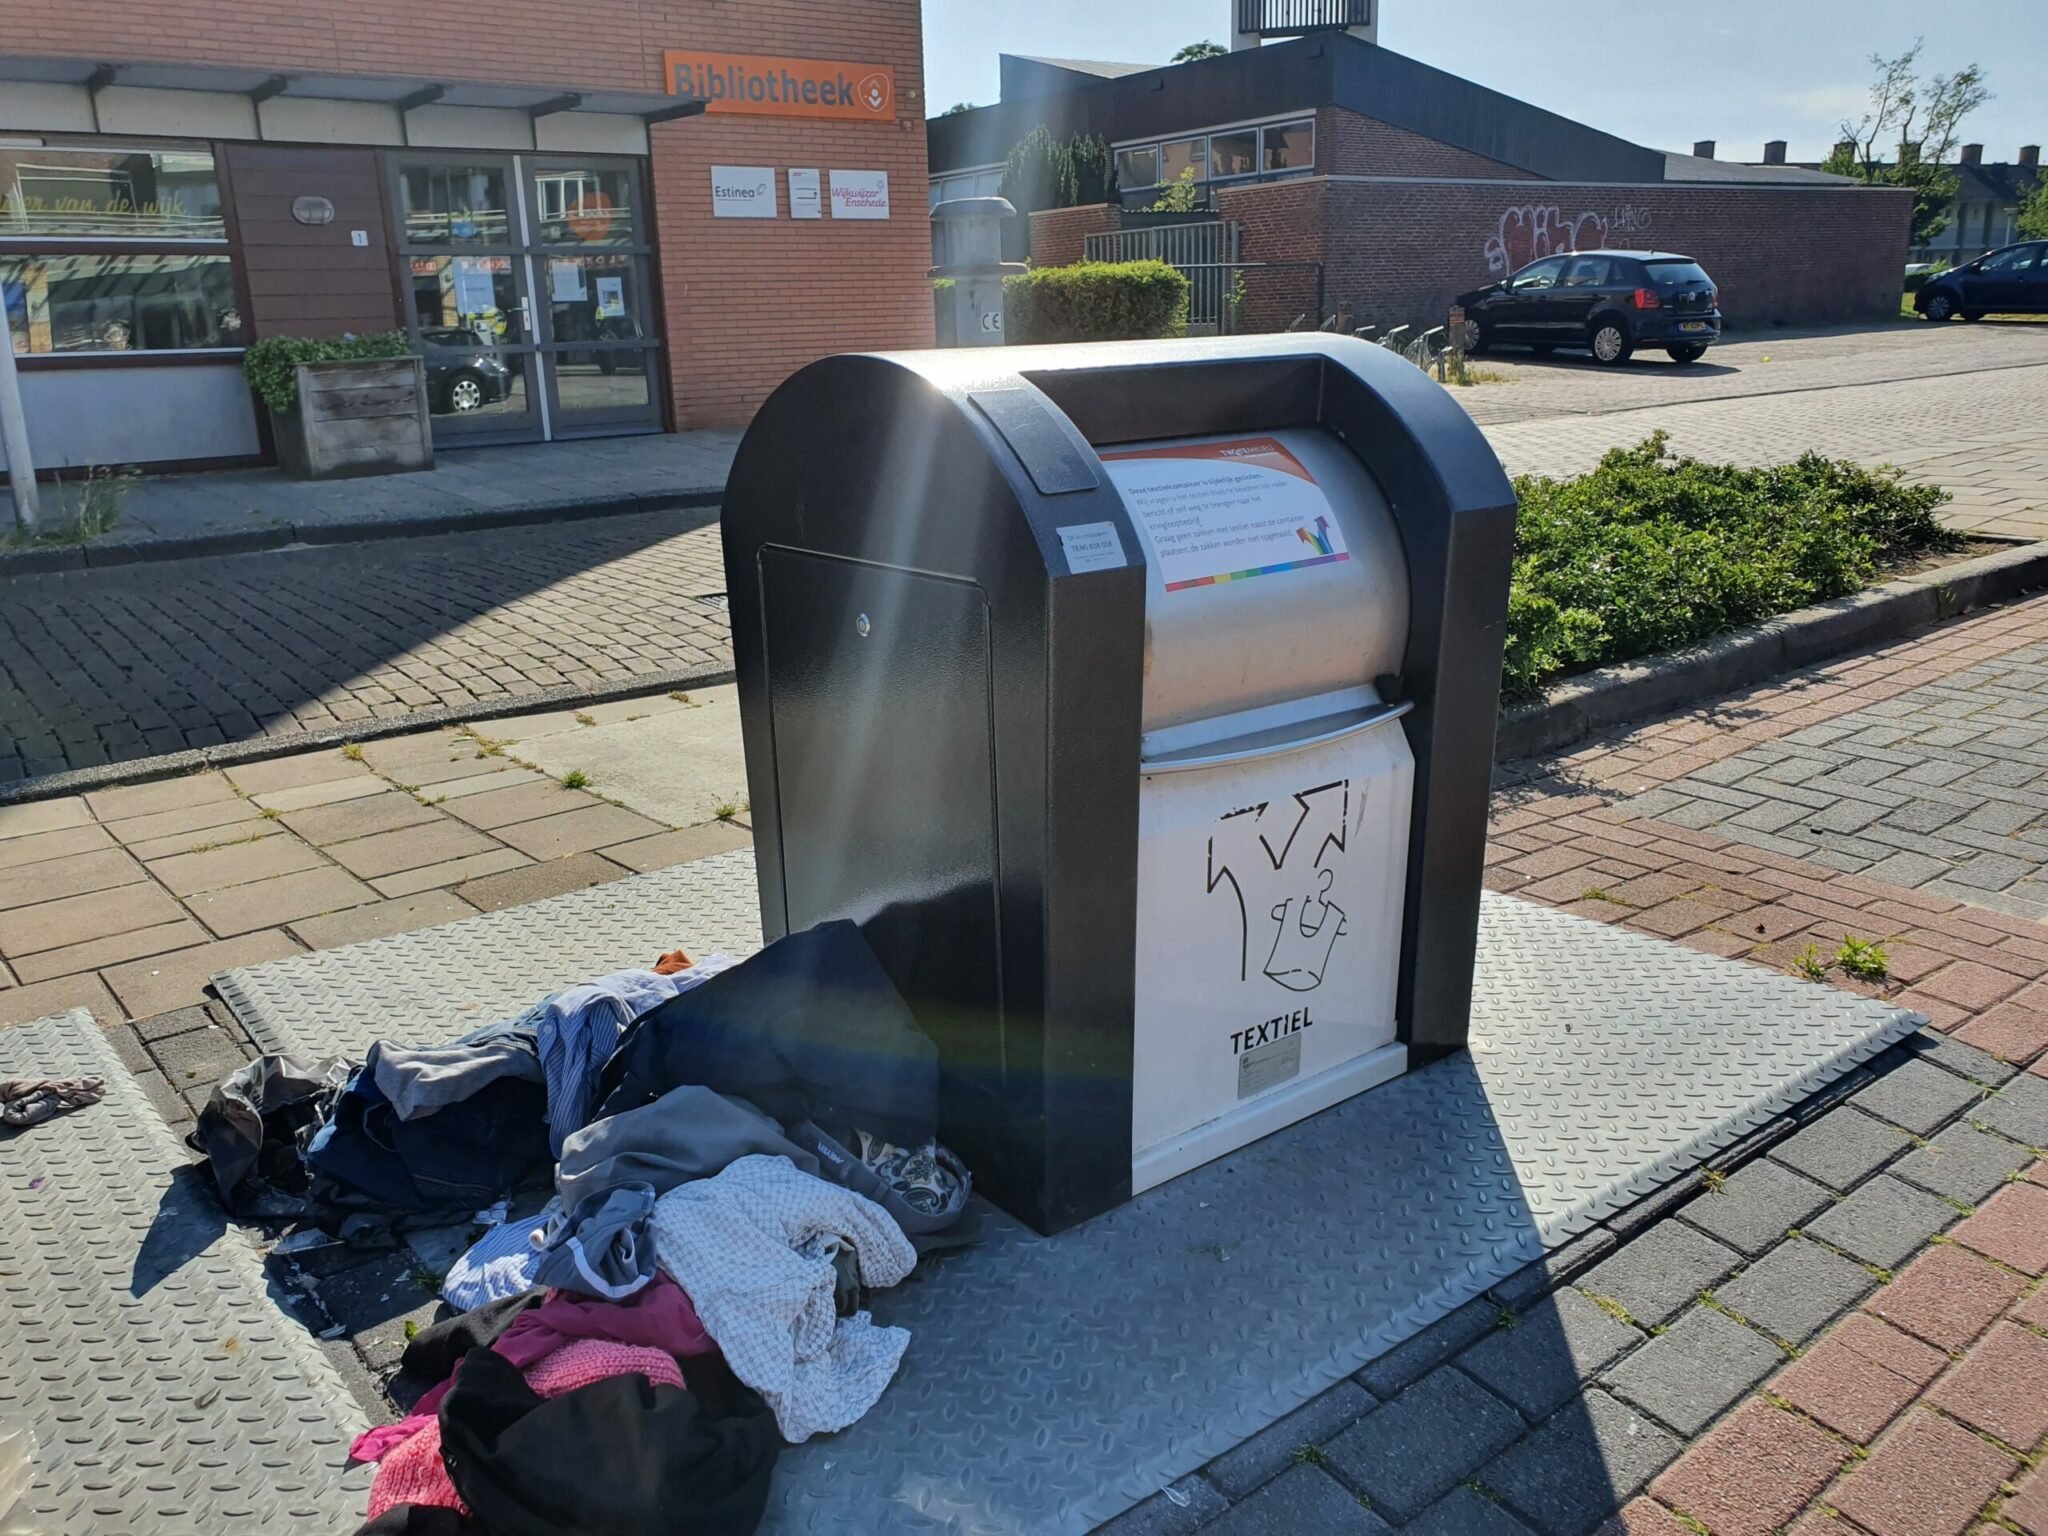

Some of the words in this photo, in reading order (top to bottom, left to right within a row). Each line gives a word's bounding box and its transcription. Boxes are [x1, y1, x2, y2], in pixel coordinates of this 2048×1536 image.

[674, 63, 855, 106] Bibliotheek
[715, 186, 755, 198] Estinea
[845, 198, 887, 207] Enschede
[982, 313, 1000, 330] CE
[1230, 1006, 1313, 1055] TEXTIEL
